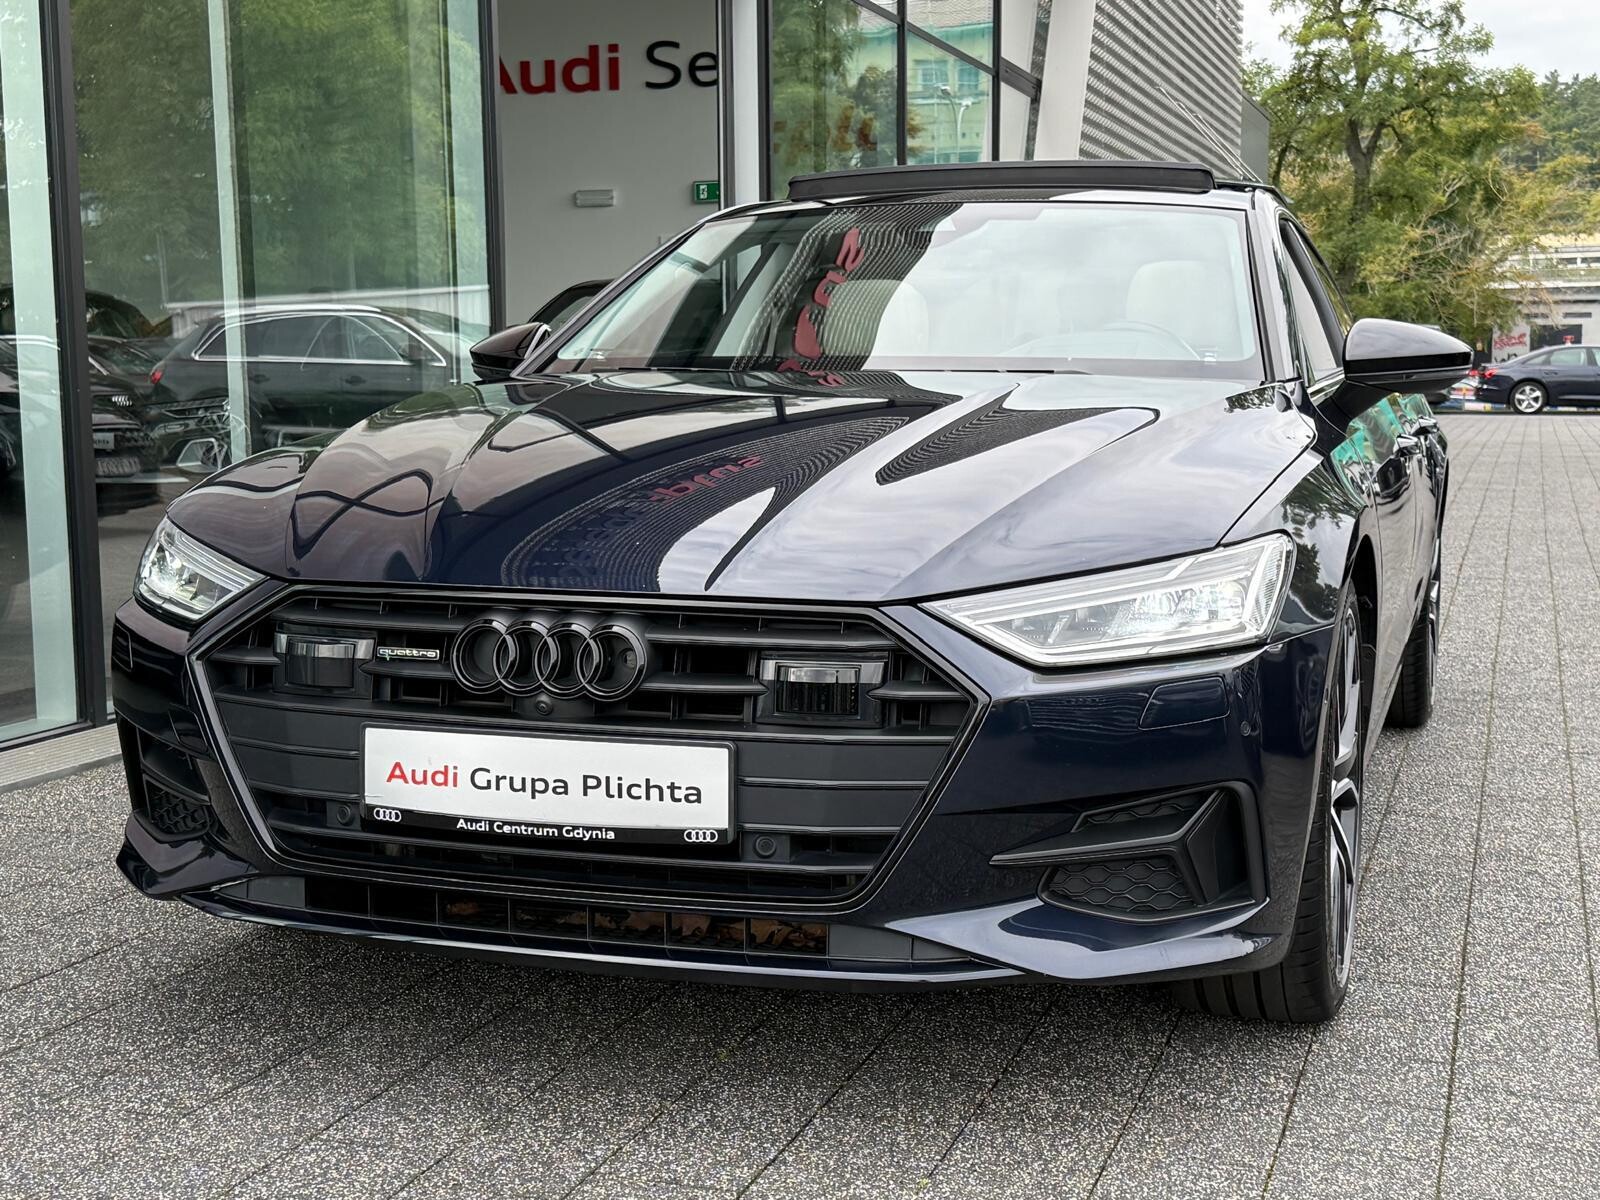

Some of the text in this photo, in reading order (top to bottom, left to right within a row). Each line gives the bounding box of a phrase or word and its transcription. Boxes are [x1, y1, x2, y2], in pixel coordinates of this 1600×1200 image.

[379, 649, 437, 661] quattro
[386, 761, 702, 804] Audi Grupa Plichta
[456, 818, 616, 841] Audi Centrum Gdynia
